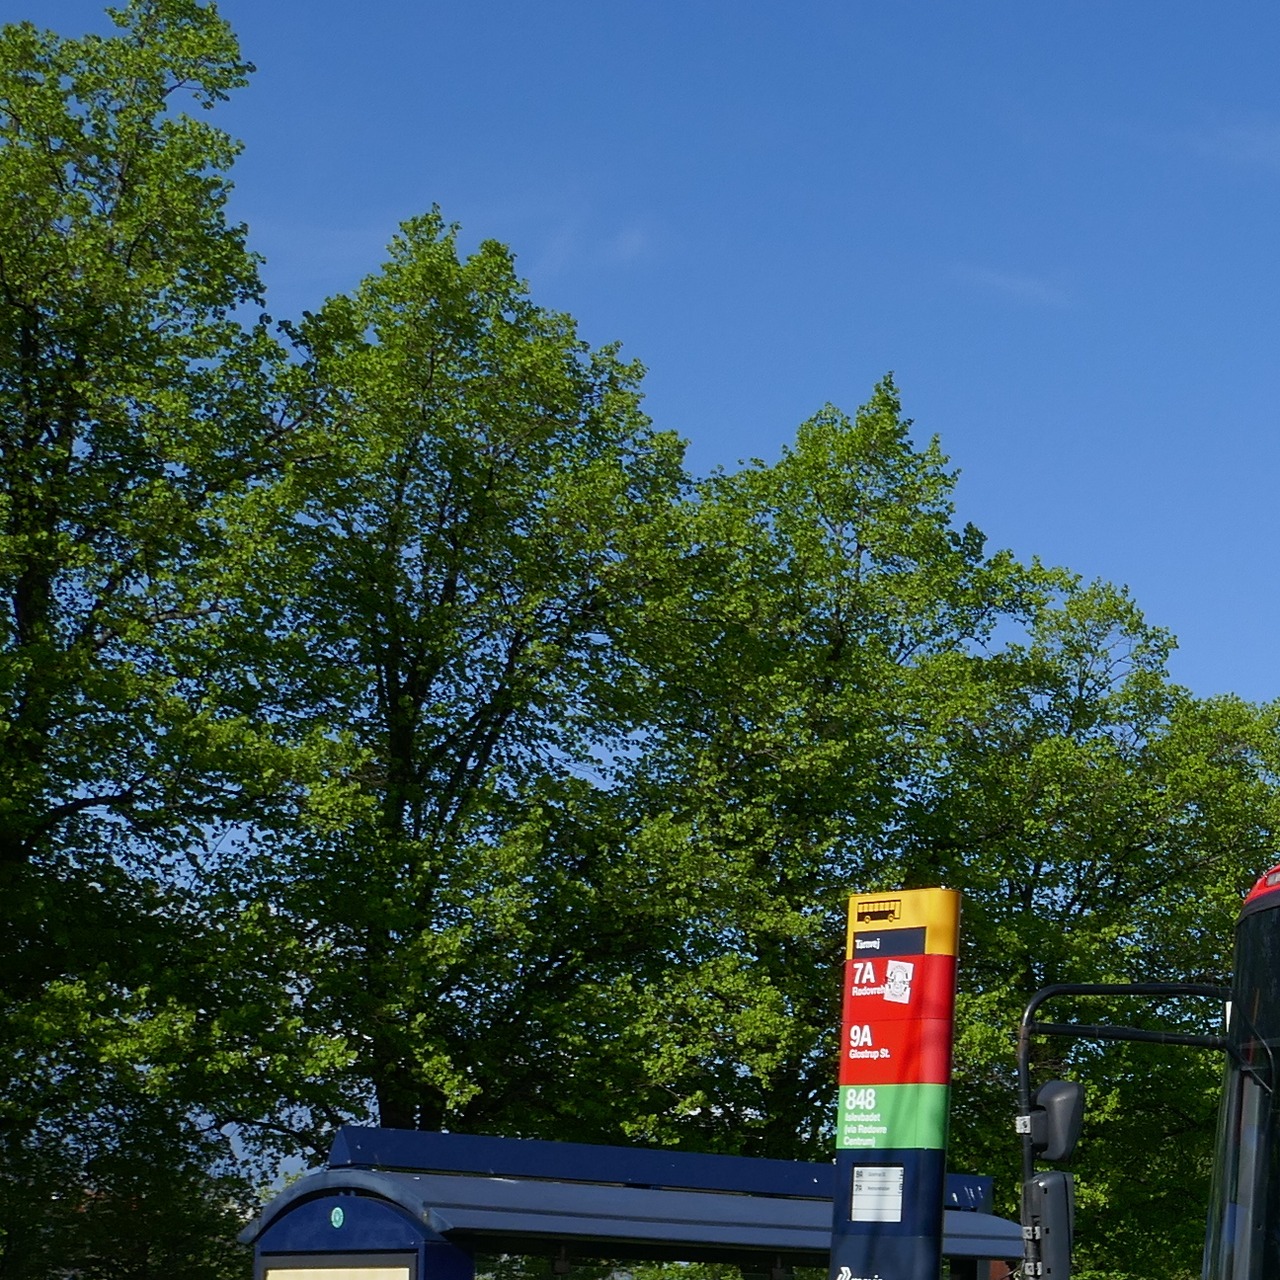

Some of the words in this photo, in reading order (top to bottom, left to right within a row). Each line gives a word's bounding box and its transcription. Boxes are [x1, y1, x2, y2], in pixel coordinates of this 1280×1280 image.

[853, 961, 875, 985] 7A
[849, 1024, 872, 1048] 9A
[845, 1087, 876, 1111] 848
